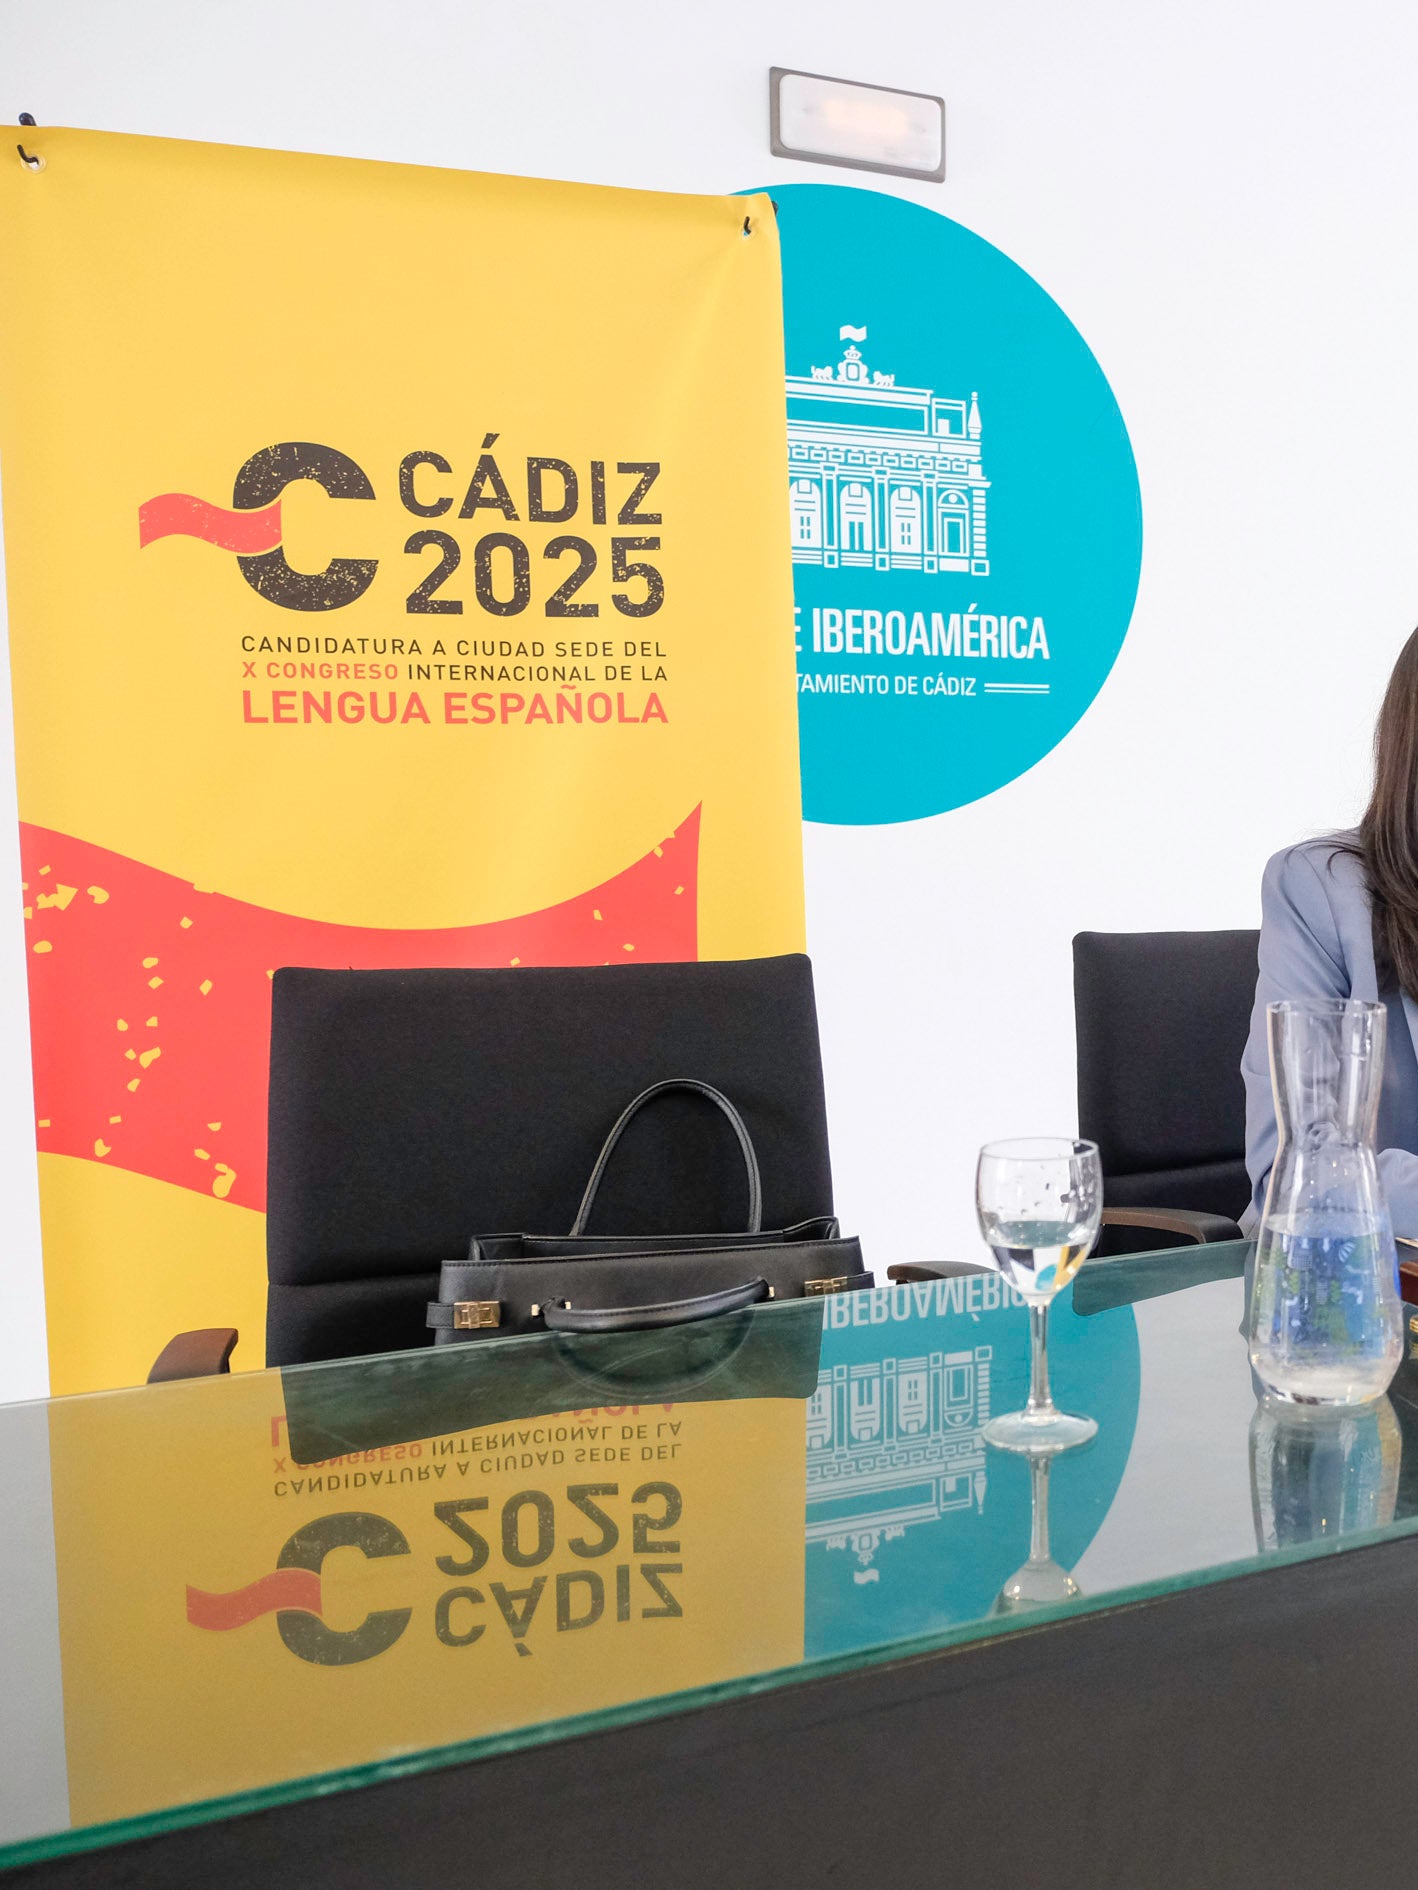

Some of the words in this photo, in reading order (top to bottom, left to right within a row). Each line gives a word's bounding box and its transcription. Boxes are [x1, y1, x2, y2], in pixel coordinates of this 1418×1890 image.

[399, 433, 662, 525] CÁDIZ
[403, 529, 665, 617] 2025
[241, 635, 422, 655] CANDIDATURA
[432, 640, 447, 656] A
[456, 640, 545, 657] CIUDAD
[555, 641, 614, 658] SEDE
[624, 641, 667, 657] DEL
[812, 603, 1050, 660] IBEROAMÉRICA
[242, 662, 257, 678] X
[267, 662, 399, 680] CONGRESO
[408, 664, 596, 682] INTERNACIONAL
[605, 664, 632, 681] DE
[640, 664, 668, 682] LA
[894, 675, 918, 695] DE
[922, 672, 976, 696] CÁDIZ
[242, 690, 432, 724] LENGUA
[444, 685, 668, 724] ESPAÑOLA
